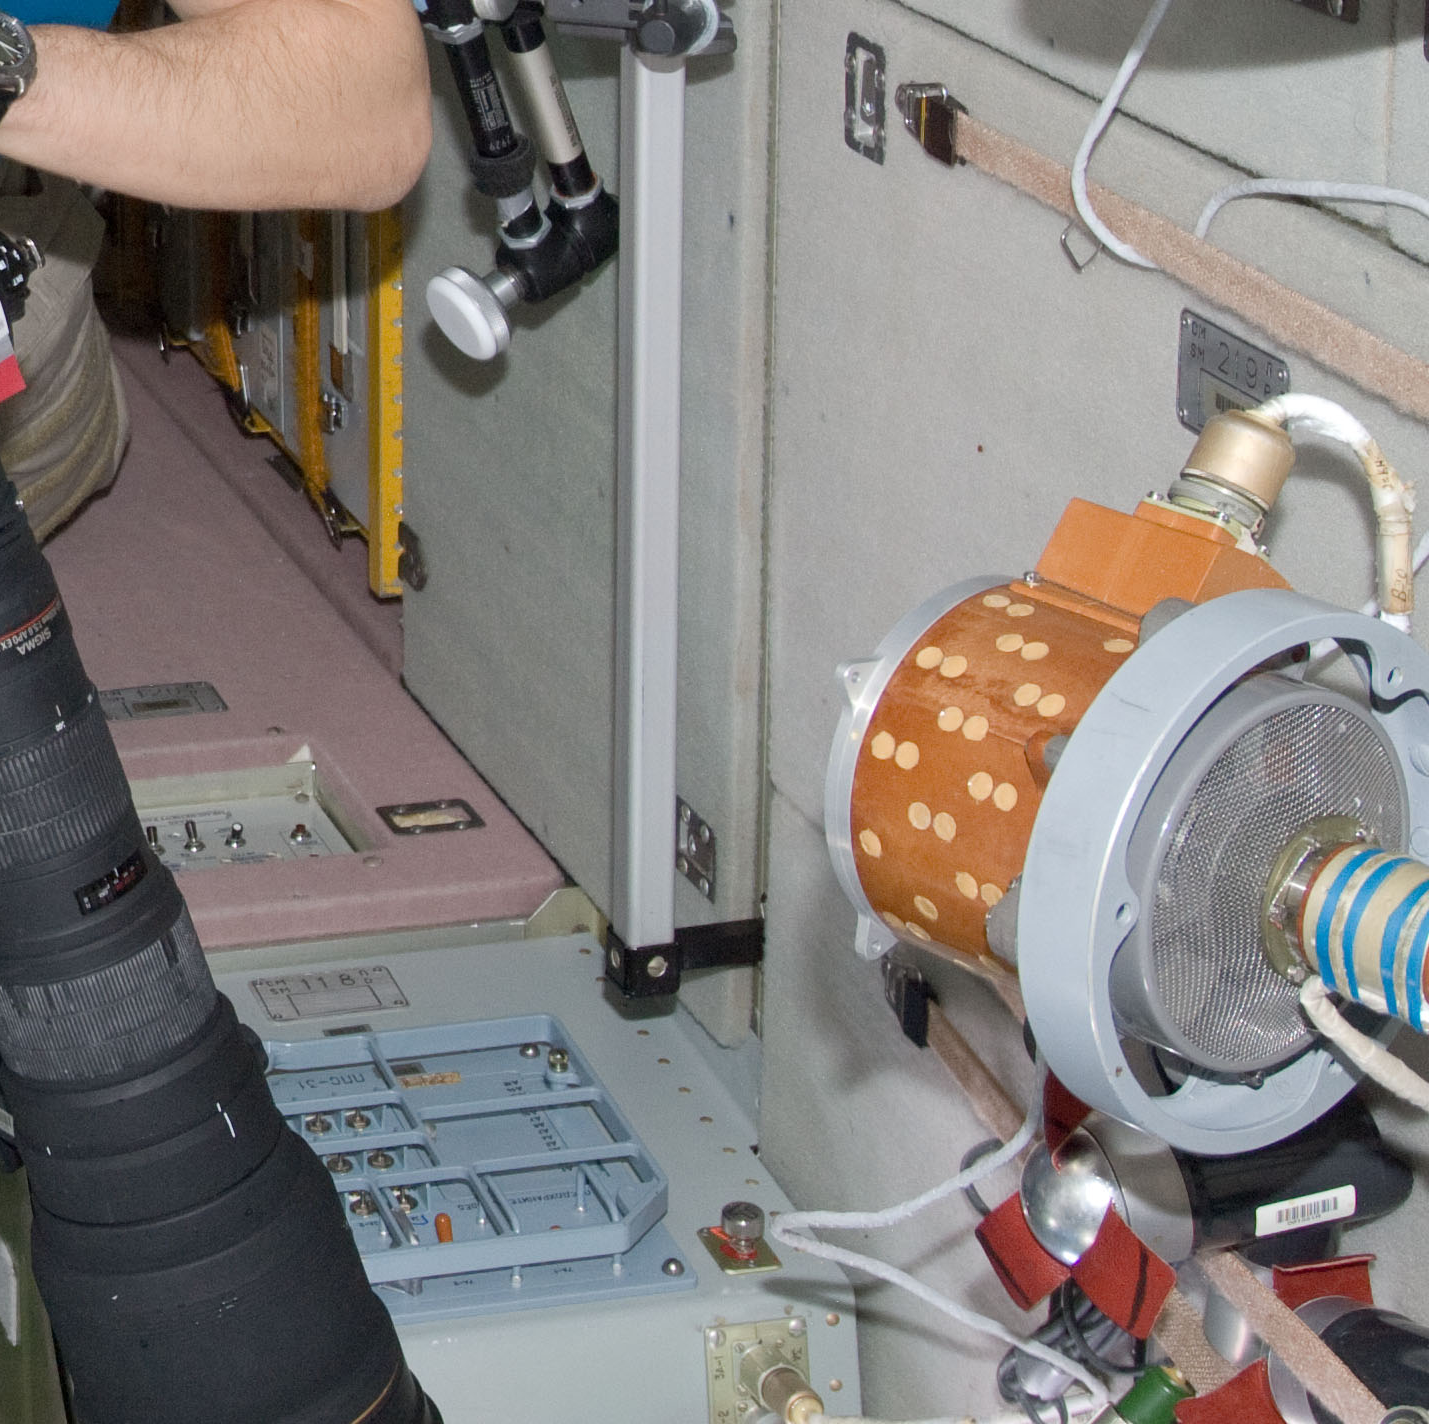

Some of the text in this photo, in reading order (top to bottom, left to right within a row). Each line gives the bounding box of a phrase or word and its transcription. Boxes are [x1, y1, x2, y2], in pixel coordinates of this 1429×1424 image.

[1189, 343, 1206, 363] SM
[0, 639, 13, 652] EX
[12, 629, 29, 646] APO
[15, 626, 53, 656] SIGMA
[300, 974, 357, 990] 118
[297, 1072, 366, 1090] ППС-31
